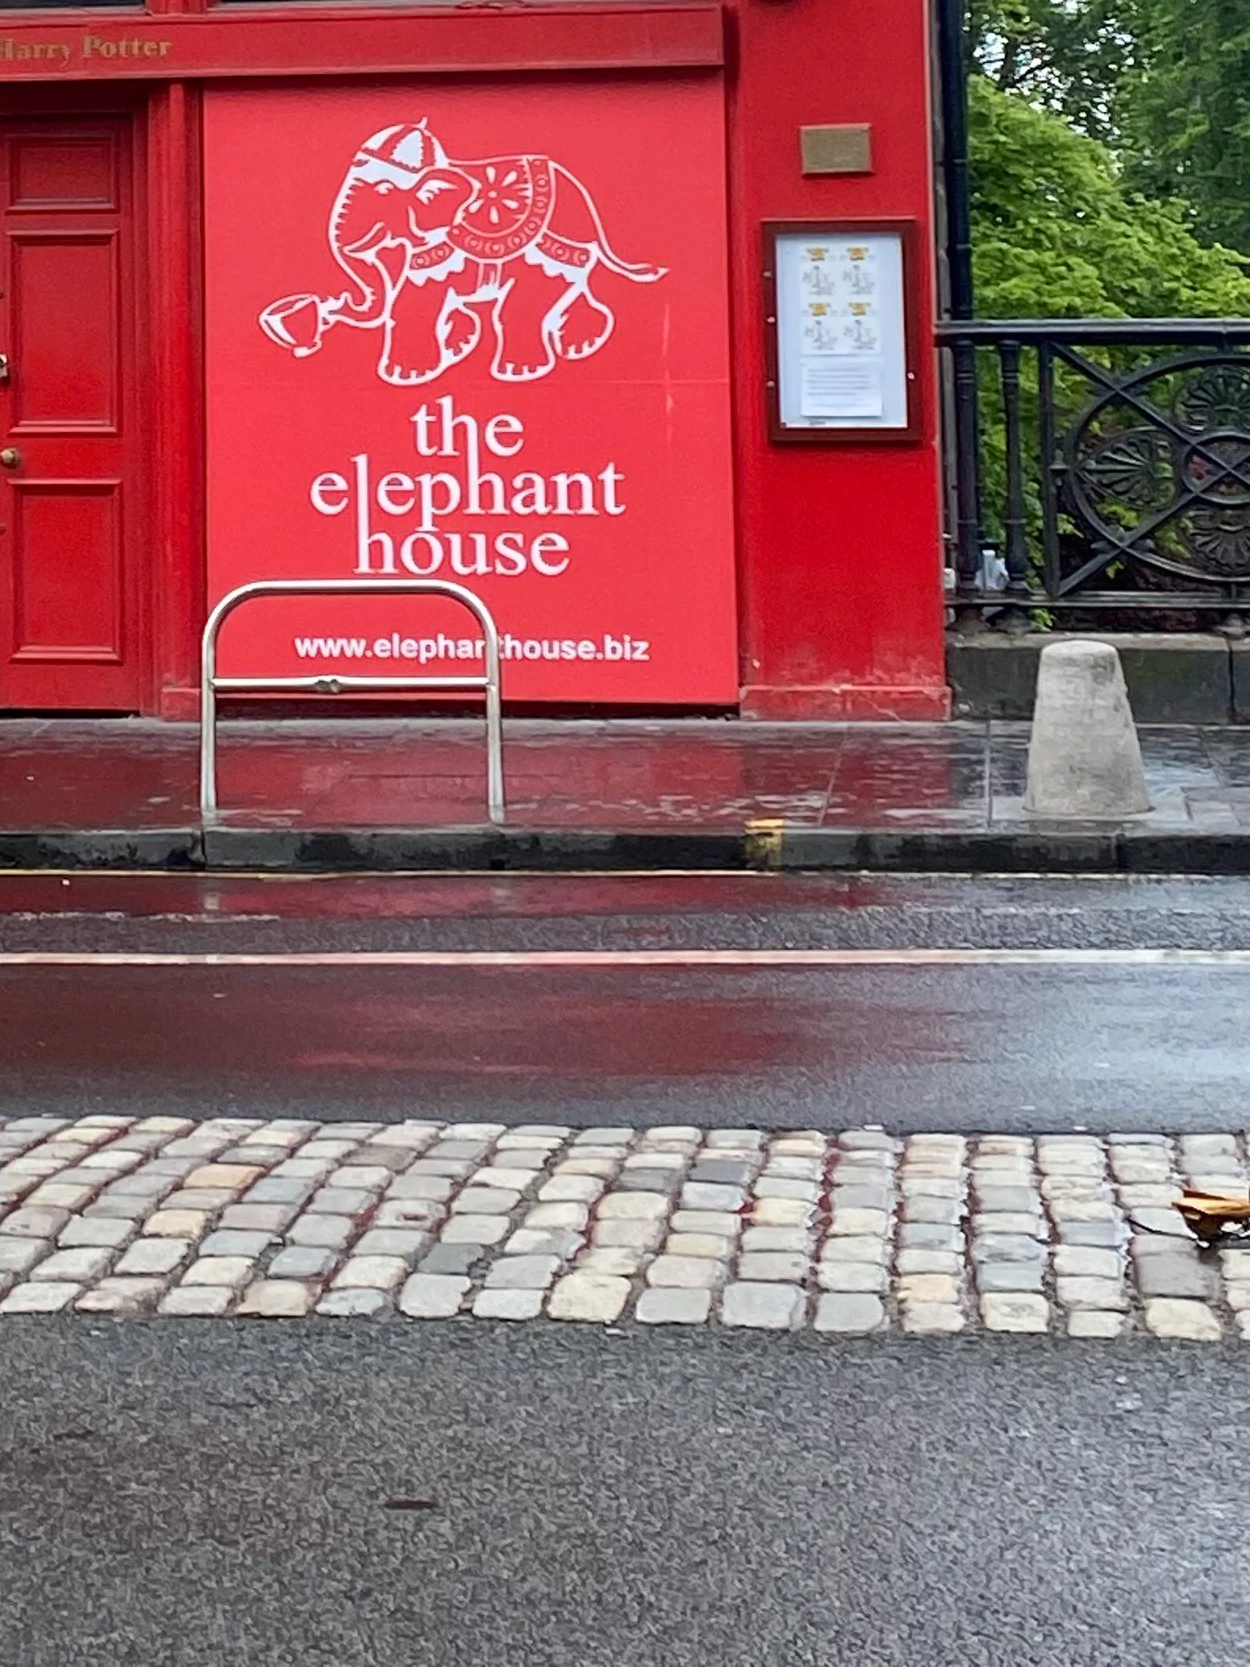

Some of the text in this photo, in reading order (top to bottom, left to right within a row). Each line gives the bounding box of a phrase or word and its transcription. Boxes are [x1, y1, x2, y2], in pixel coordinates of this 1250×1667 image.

[81, 34, 172, 60] Potter
[410, 395, 525, 457] the
[310, 453, 626, 532] elephant
[352, 531, 570, 576] house
